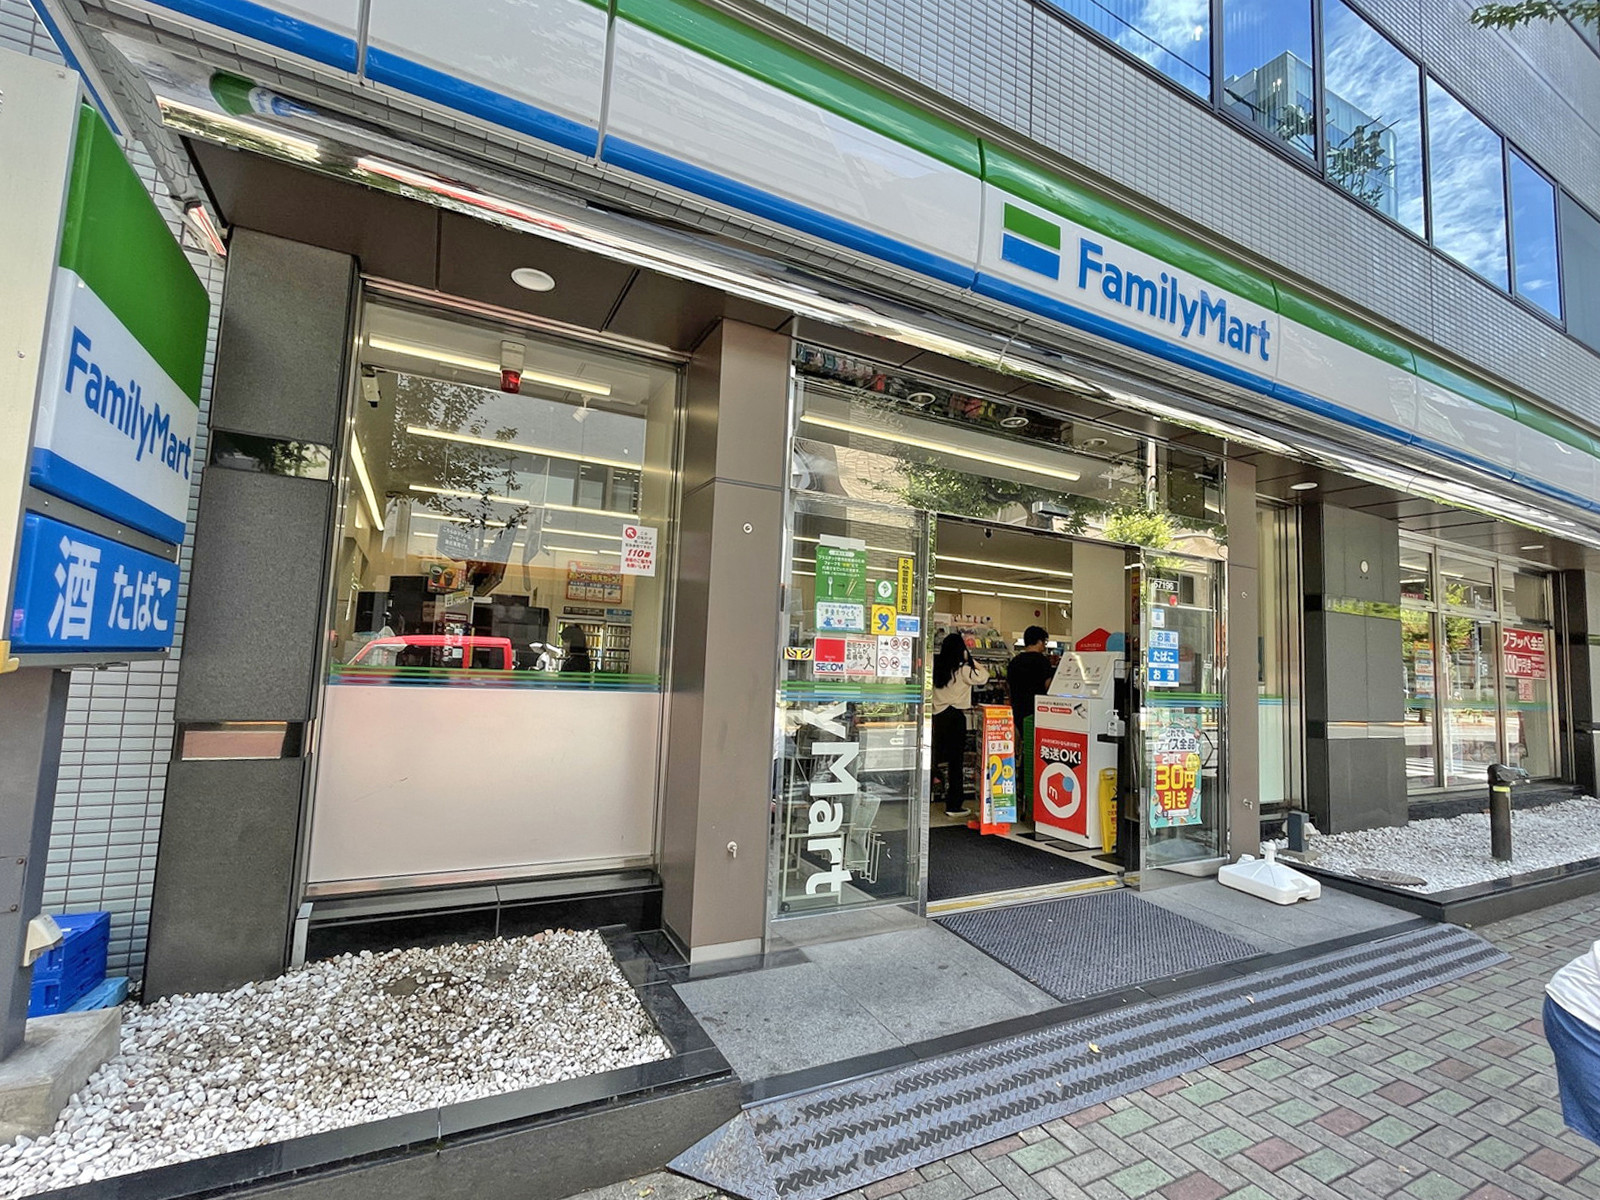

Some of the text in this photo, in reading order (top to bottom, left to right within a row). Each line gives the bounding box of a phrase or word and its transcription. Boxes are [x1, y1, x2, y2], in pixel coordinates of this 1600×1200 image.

[1078, 238, 1270, 361] FamilyMart
[65, 326, 191, 480] FamilyMart
[48, 535, 171, 640] 酒 たばこ
[1503, 631, 1545, 651] フラッペ全品
[1153, 650, 1174, 662] たばこ
[1504, 655, 1532, 674] 100円引き
[815, 662, 844, 672] SECOM
[1153, 669, 1175, 681] お酒
[1040, 745, 1082, 764] 発送OK!
[1158, 739, 1196, 751] アイス全品
[1154, 765, 1196, 790] 30円
[1163, 790, 1188, 809] 引き
